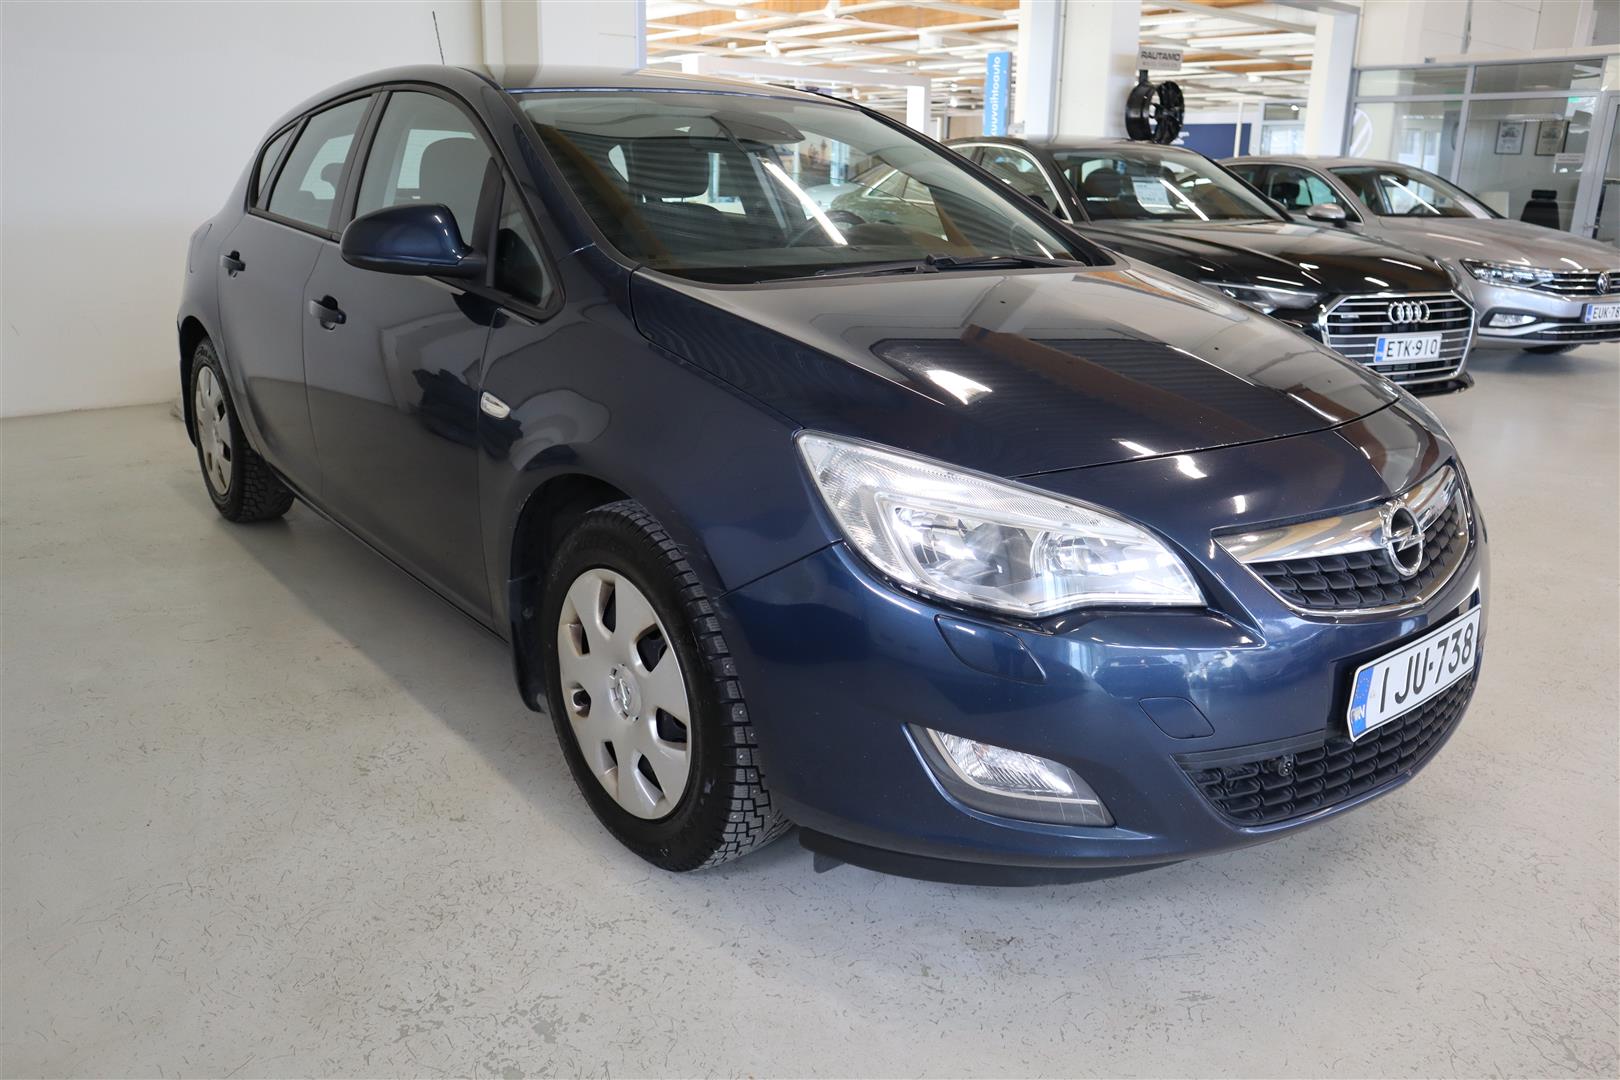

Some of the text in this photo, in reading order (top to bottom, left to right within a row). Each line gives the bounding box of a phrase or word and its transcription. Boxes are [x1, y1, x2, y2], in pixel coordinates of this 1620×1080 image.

[1141, 51, 1180, 61] RAUTAMO
[1386, 339, 1438, 358] ETK-910
[1379, 622, 1474, 714] IJU-738
